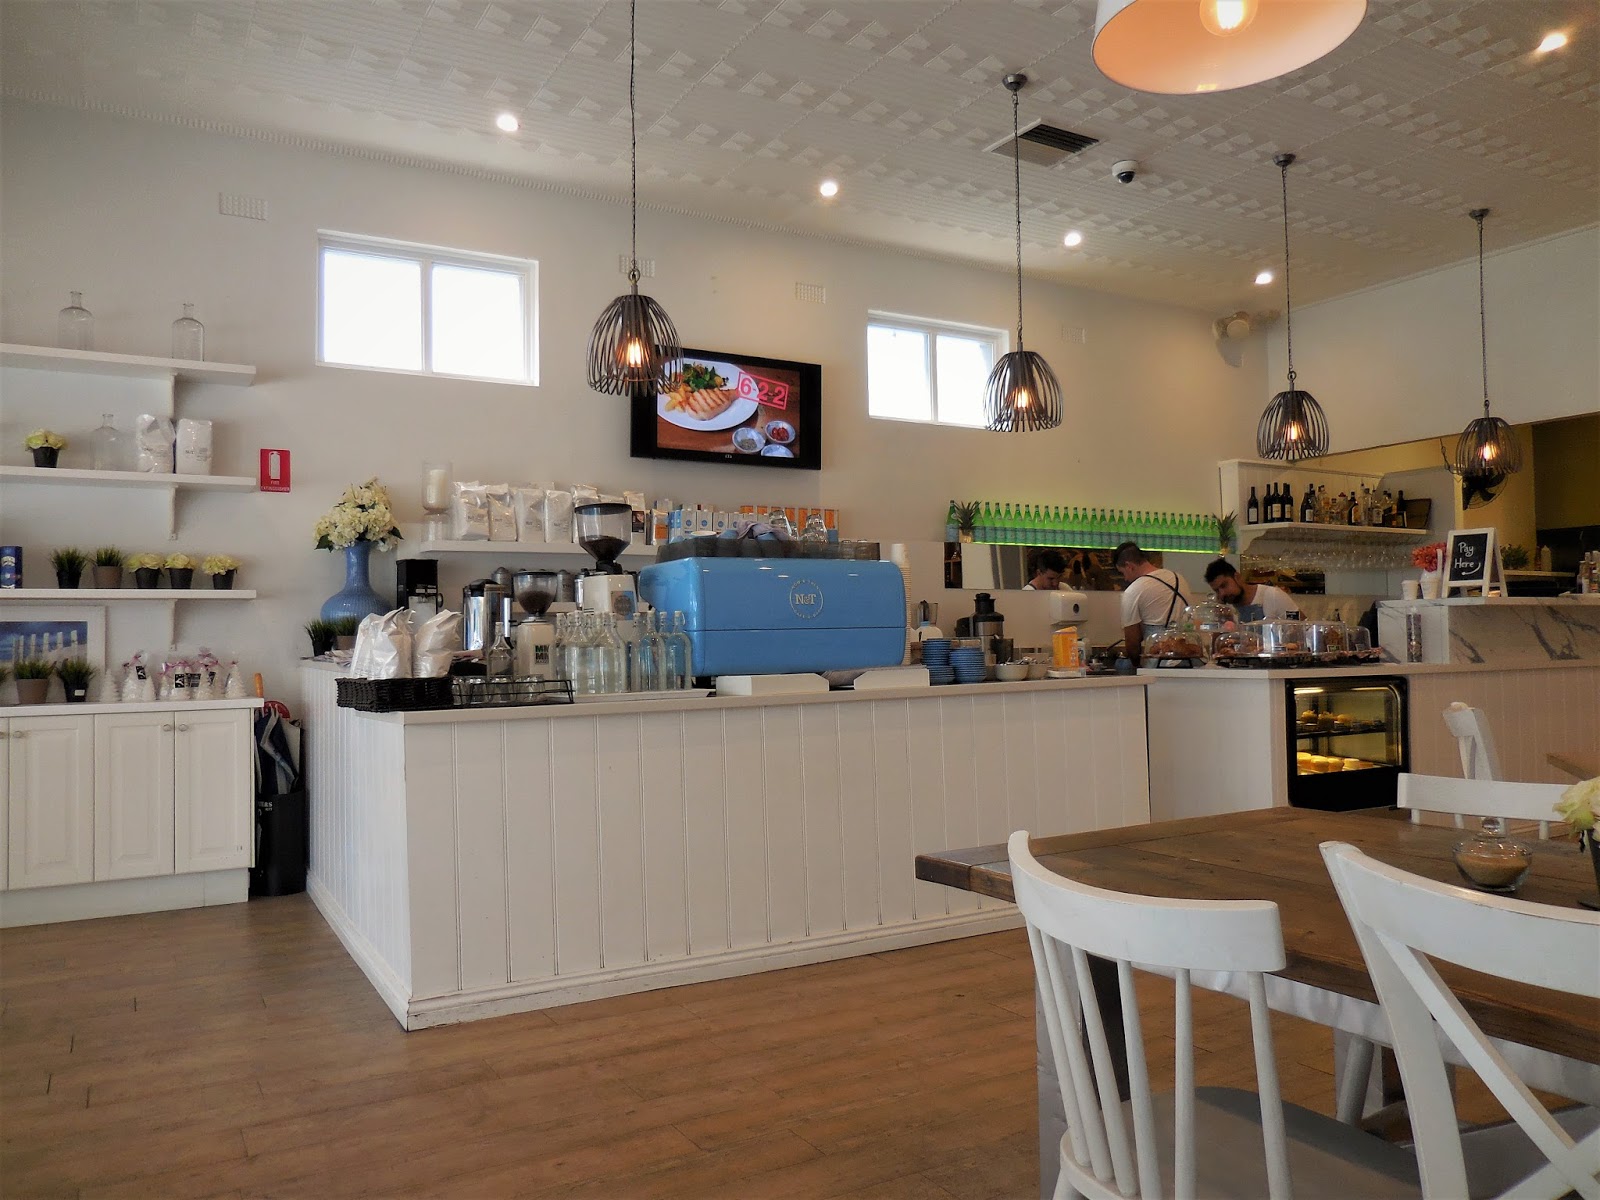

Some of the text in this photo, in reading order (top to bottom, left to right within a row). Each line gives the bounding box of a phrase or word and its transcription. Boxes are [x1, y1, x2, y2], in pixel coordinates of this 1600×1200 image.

[741, 377, 785, 406] 6-2-2
[1457, 541, 1474, 557] Pay
[1454, 558, 1475, 569] Here
